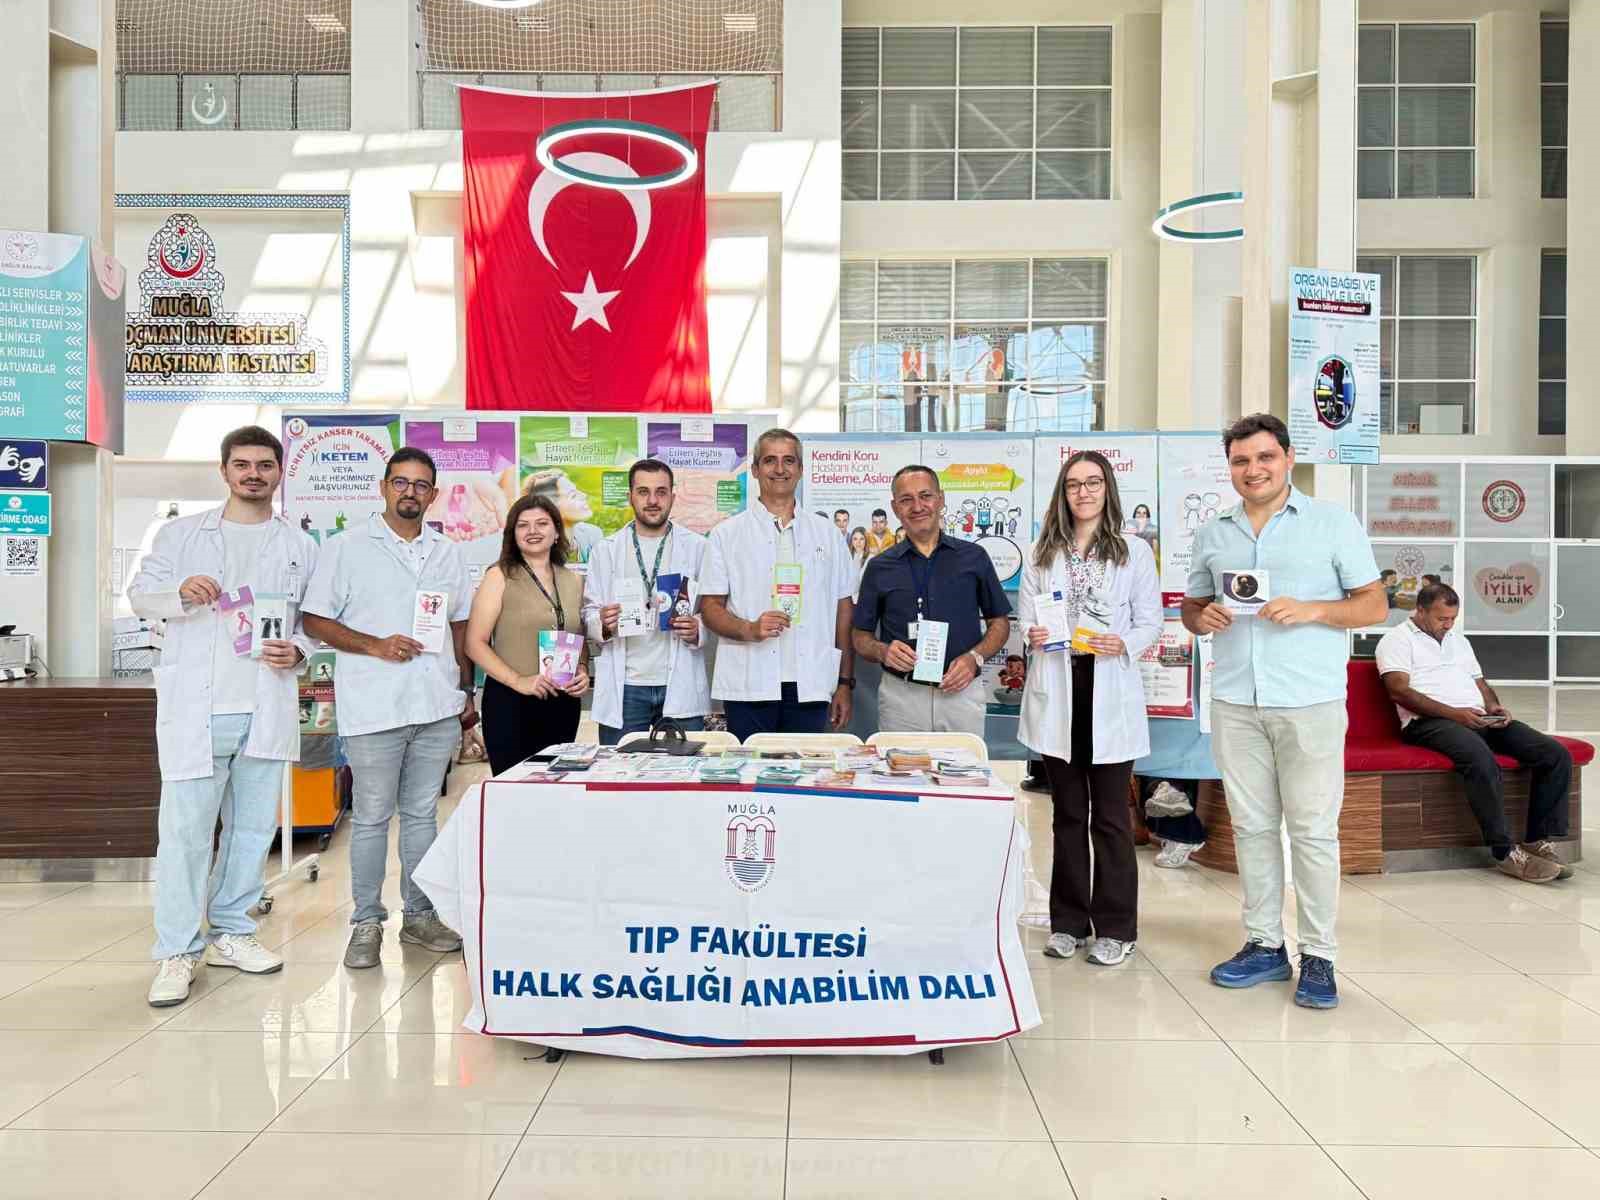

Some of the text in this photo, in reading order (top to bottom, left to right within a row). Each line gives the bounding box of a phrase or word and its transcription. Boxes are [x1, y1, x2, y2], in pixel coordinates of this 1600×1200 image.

[1294, 273, 1329, 287] ORGAN
[1362, 280, 1376, 291] VE
[151, 293, 212, 317] MUĞLA
[184, 321, 296, 346] ÜNİVERSİTESİ
[129, 350, 316, 378] ARAŞTIRMA HASTANESİ
[317, 427, 353, 441] KANSER
[321, 452, 369, 461] KETEM
[811, 449, 879, 461] Kendini Koru
[1485, 581, 1533, 596] İYİLİK
[727, 802, 776, 815] MUĞLA
[625, 924, 867, 959] TIP FAKÜLTESİ
[492, 967, 997, 1007] HALK SAĞLIĞI ANABİLİM DALI
